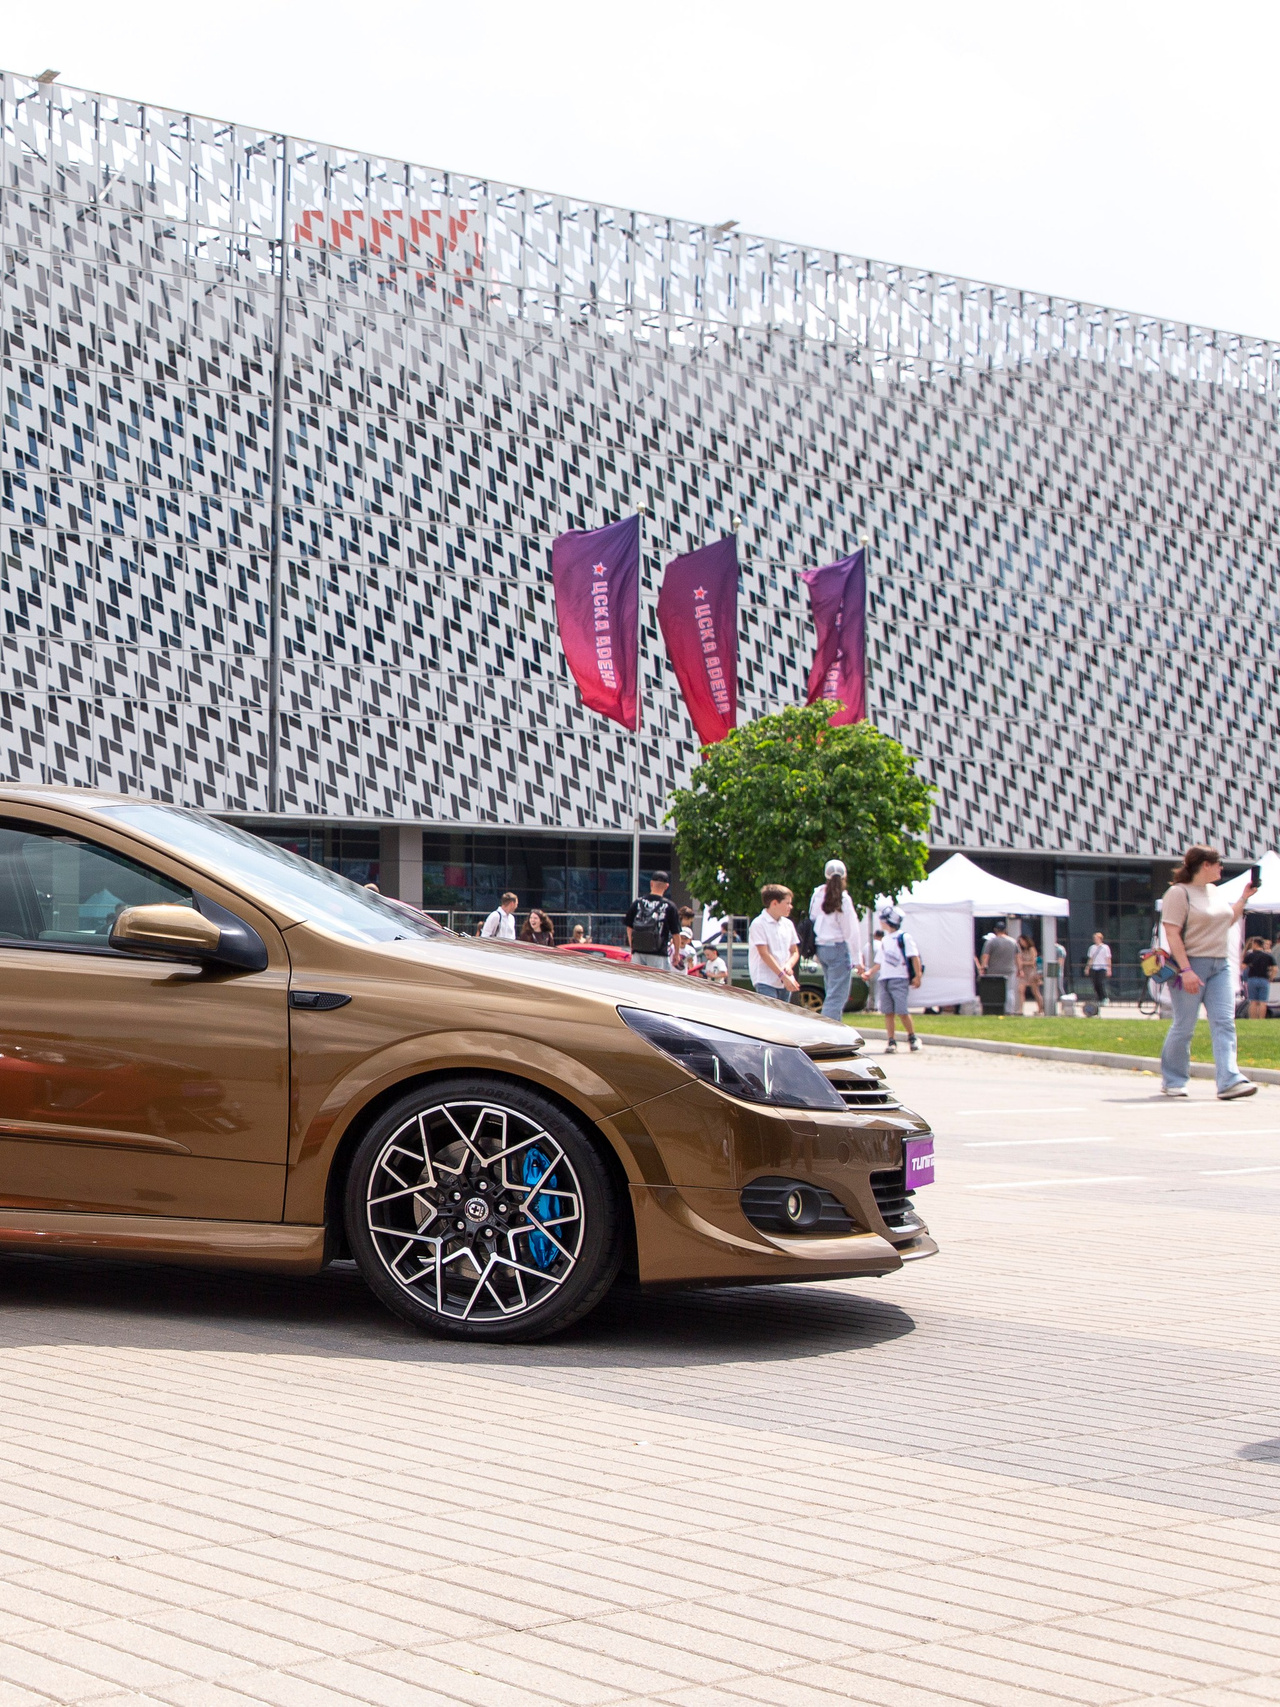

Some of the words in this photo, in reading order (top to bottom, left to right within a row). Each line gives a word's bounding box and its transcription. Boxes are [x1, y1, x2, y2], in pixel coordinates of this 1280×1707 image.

[591, 581, 610, 632] ЦСКА
[694, 603, 718, 654] ЦСКА
[595, 635, 617, 689] АРЕНА
[705, 656, 731, 714] АРЕНА
